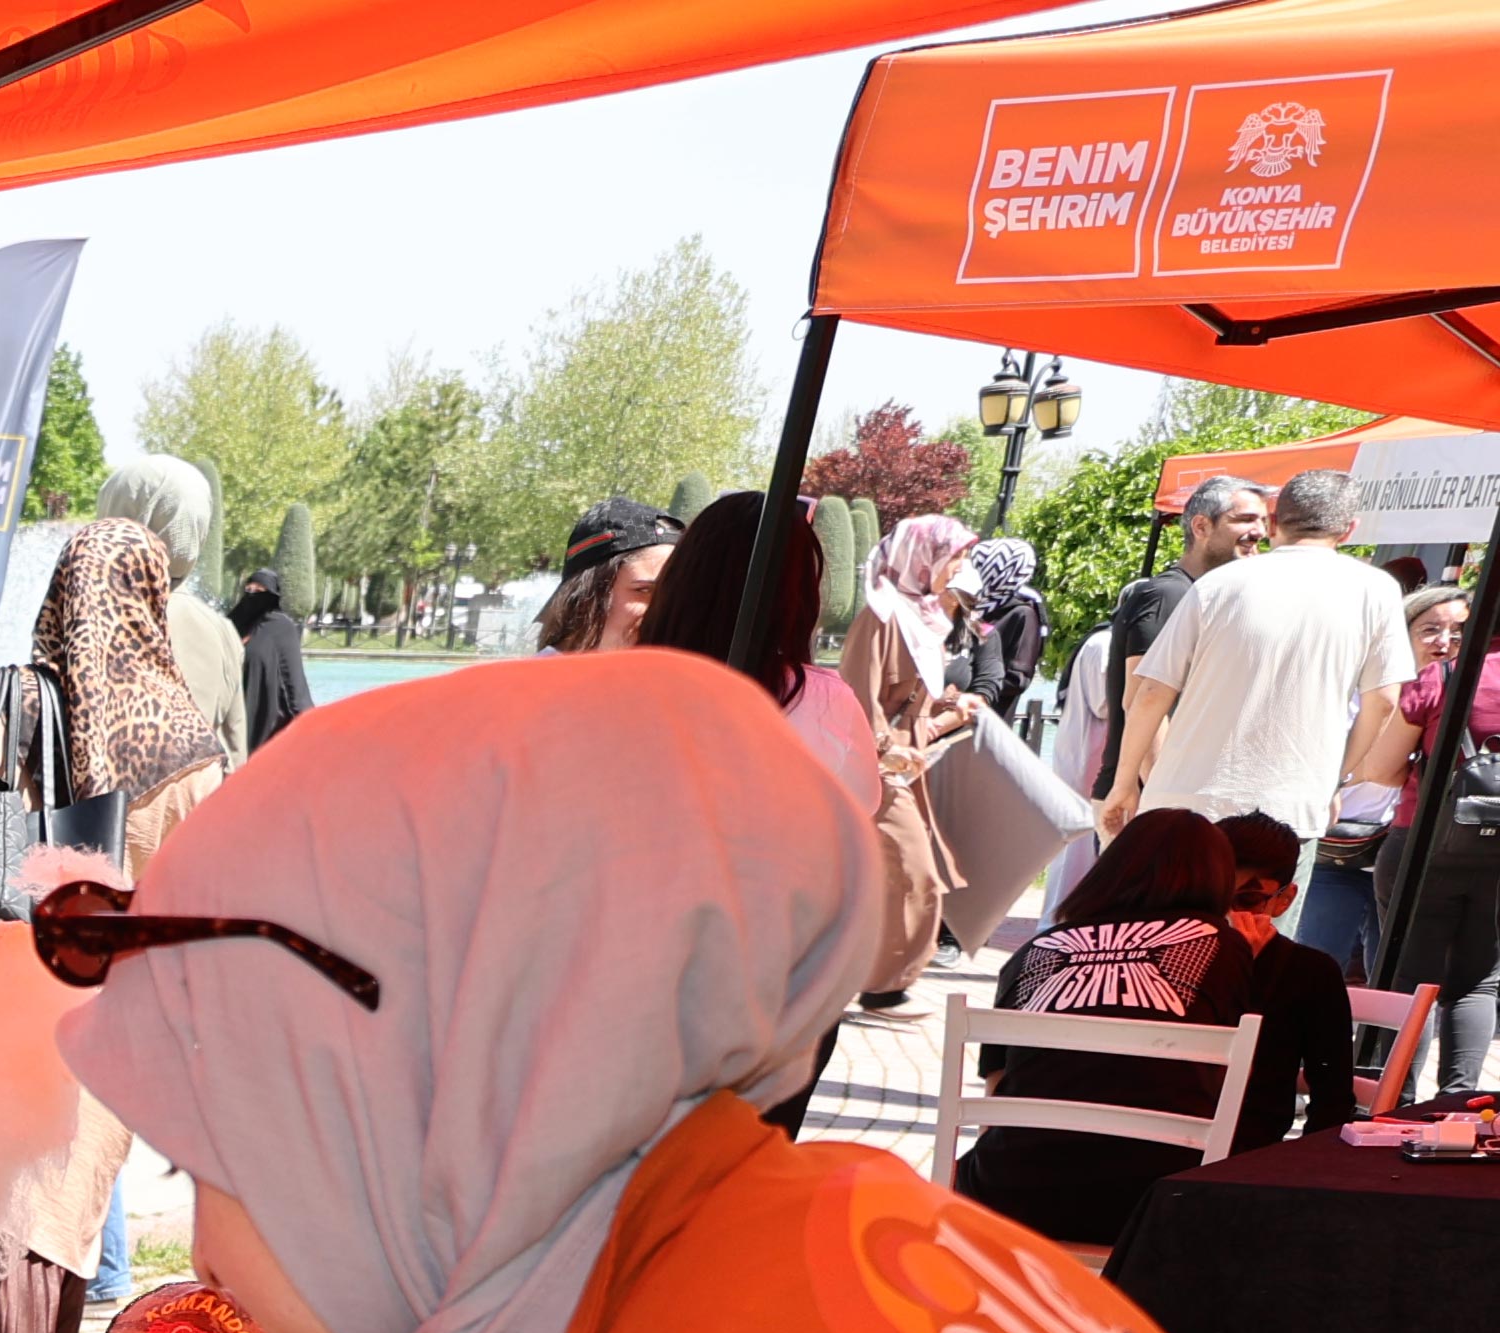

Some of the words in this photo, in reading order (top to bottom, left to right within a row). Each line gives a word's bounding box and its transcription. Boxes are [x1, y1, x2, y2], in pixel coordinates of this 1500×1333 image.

[987, 139, 1150, 190] BENİM
[1219, 184, 1302, 207] KONYA
[983, 191, 1136, 239] ŞEHRİM
[1171, 202, 1337, 237] BÜYÜKŞEHİR
[1200, 231, 1296, 254] BELEDİYESİ
[1378, 469, 1460, 511] GÖNÜLLÜLER
[1032, 919, 1167, 954] SNEAKS
[1068, 951, 1126, 963] SNEAKS
